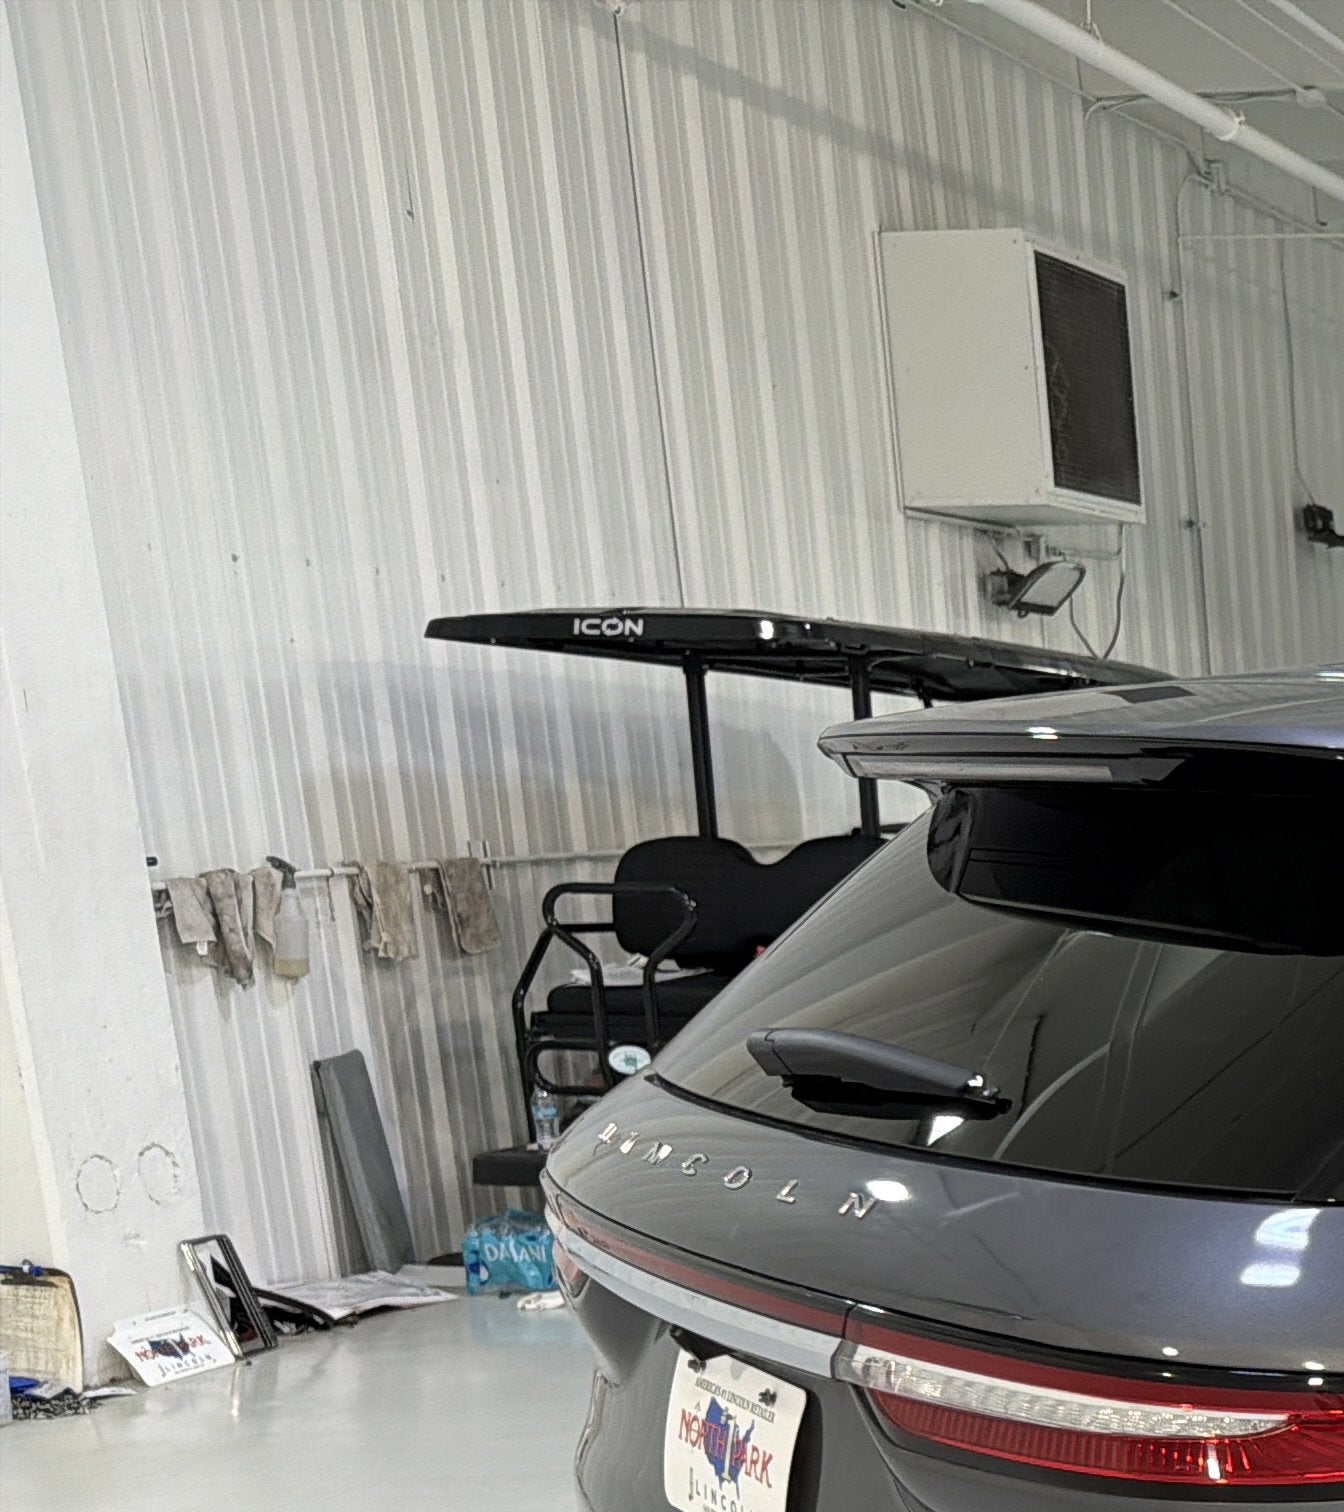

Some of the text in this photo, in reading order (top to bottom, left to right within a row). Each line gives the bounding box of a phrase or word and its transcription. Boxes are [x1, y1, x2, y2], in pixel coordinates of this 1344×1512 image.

[573, 617, 644, 637] ICON
[597, 1121, 877, 1220] LINCOLN
[484, 1234, 546, 1264] DASANI
[678, 1407, 774, 1489] NORTH PARK
